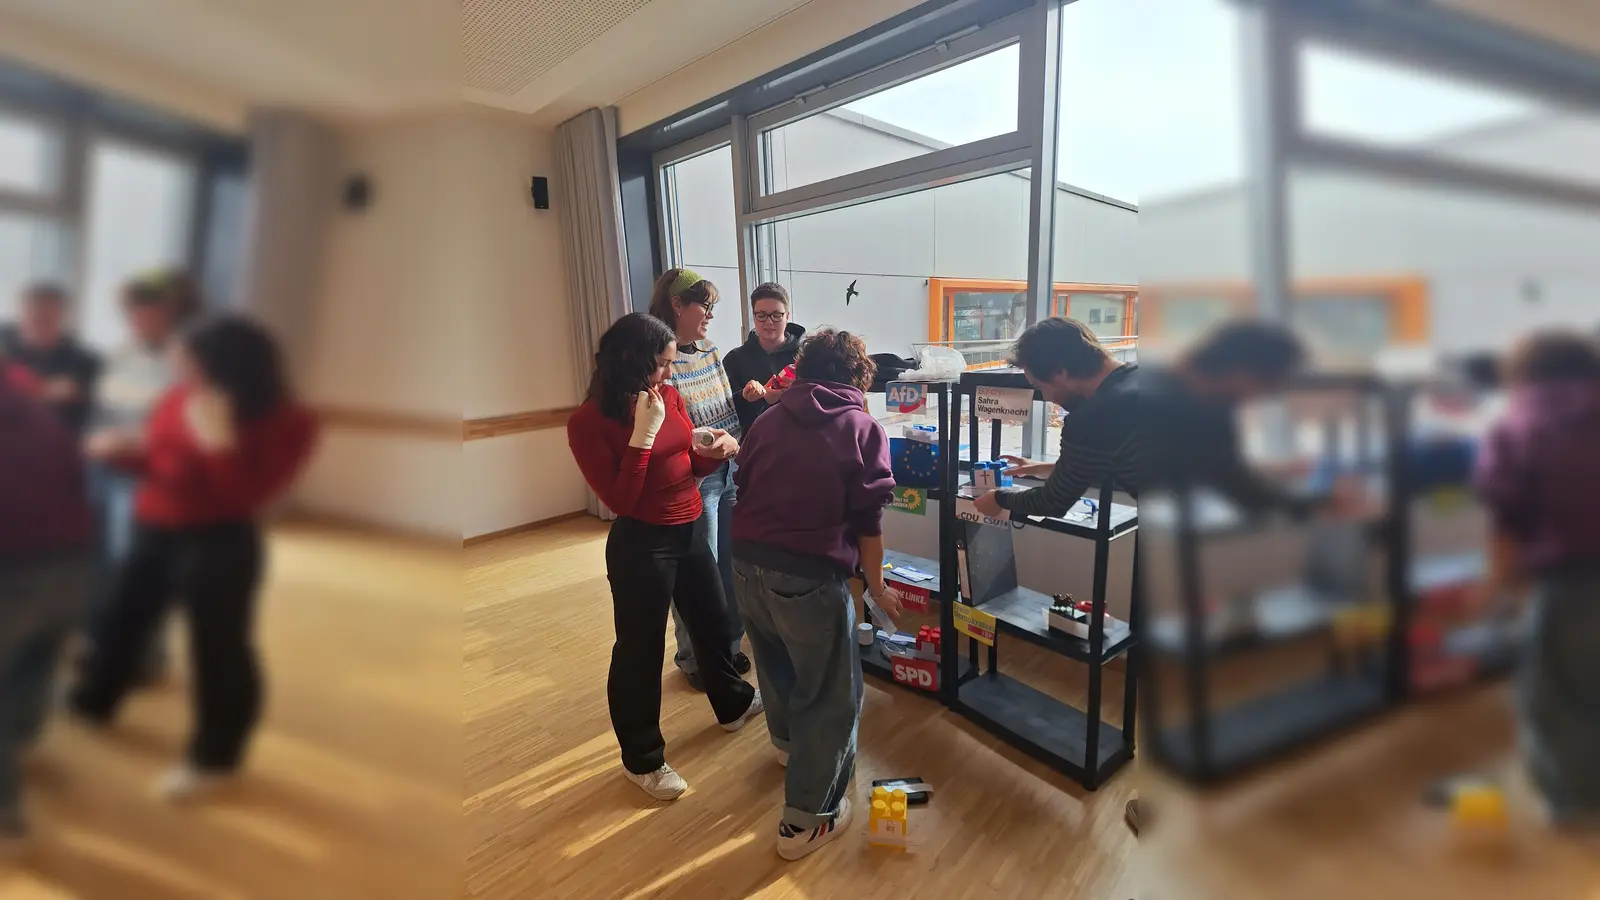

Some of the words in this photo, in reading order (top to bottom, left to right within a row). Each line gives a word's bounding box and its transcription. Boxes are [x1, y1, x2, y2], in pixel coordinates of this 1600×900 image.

[888, 385, 919, 403] AfD
[977, 396, 999, 406] Sahra
[977, 404, 1029, 417] Wagenknecht
[960, 511, 980, 522] CDU
[983, 516, 1000, 526] CSU
[894, 664, 932, 687] SPD
